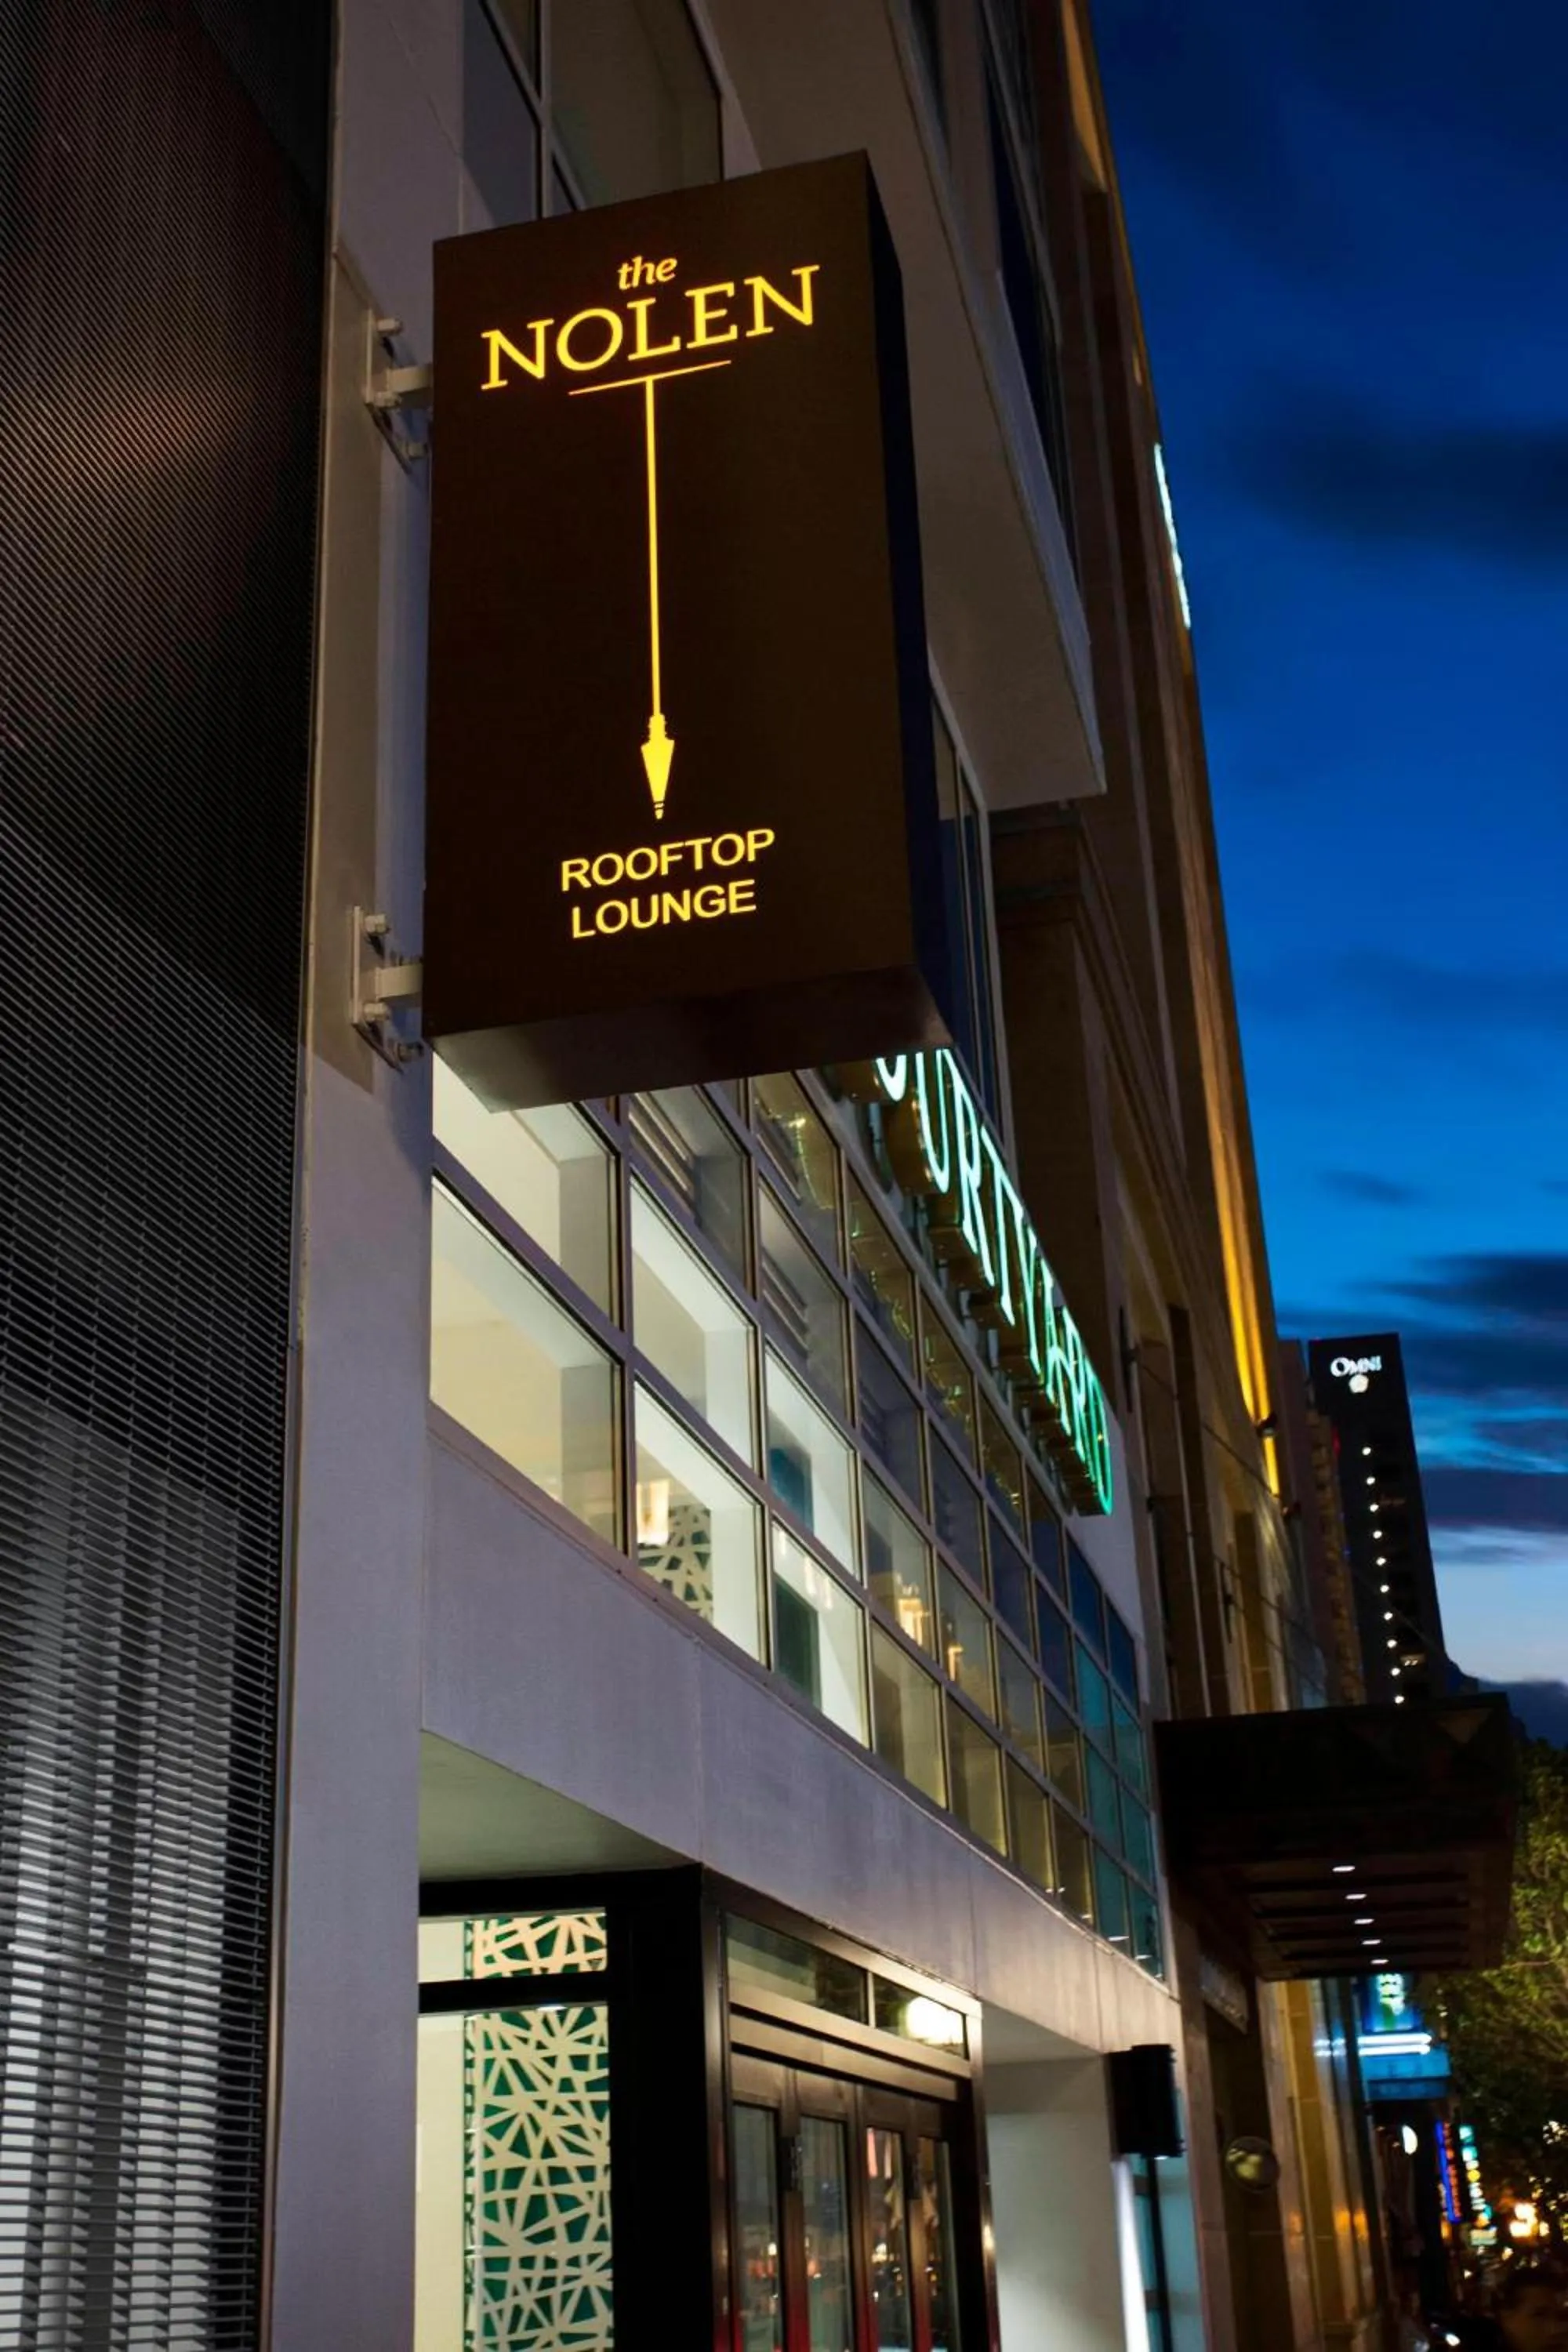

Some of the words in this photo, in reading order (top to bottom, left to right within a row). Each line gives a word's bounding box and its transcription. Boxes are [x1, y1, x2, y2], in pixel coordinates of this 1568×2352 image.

[617, 255, 678, 291] the
[480, 263, 821, 390] NOLEN
[560, 828, 776, 892] ROOFTOP
[572, 878, 757, 939] LOUNGE
